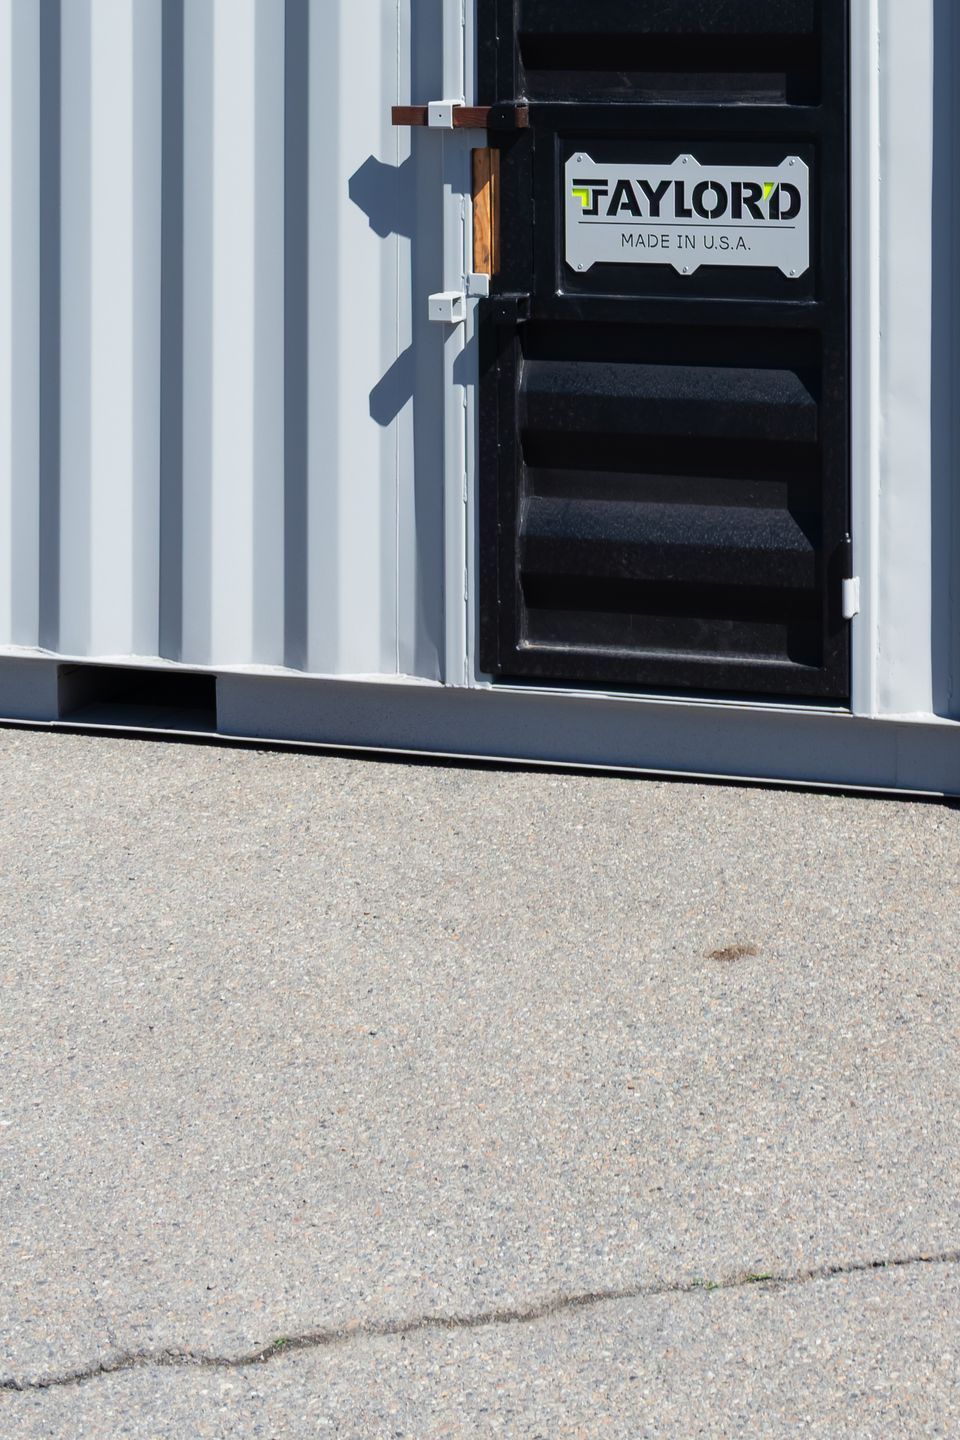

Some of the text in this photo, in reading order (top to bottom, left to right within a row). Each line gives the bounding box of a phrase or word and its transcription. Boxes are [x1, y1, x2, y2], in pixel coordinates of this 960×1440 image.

[621, 233, 751, 251] MADE IN U.S.A.
